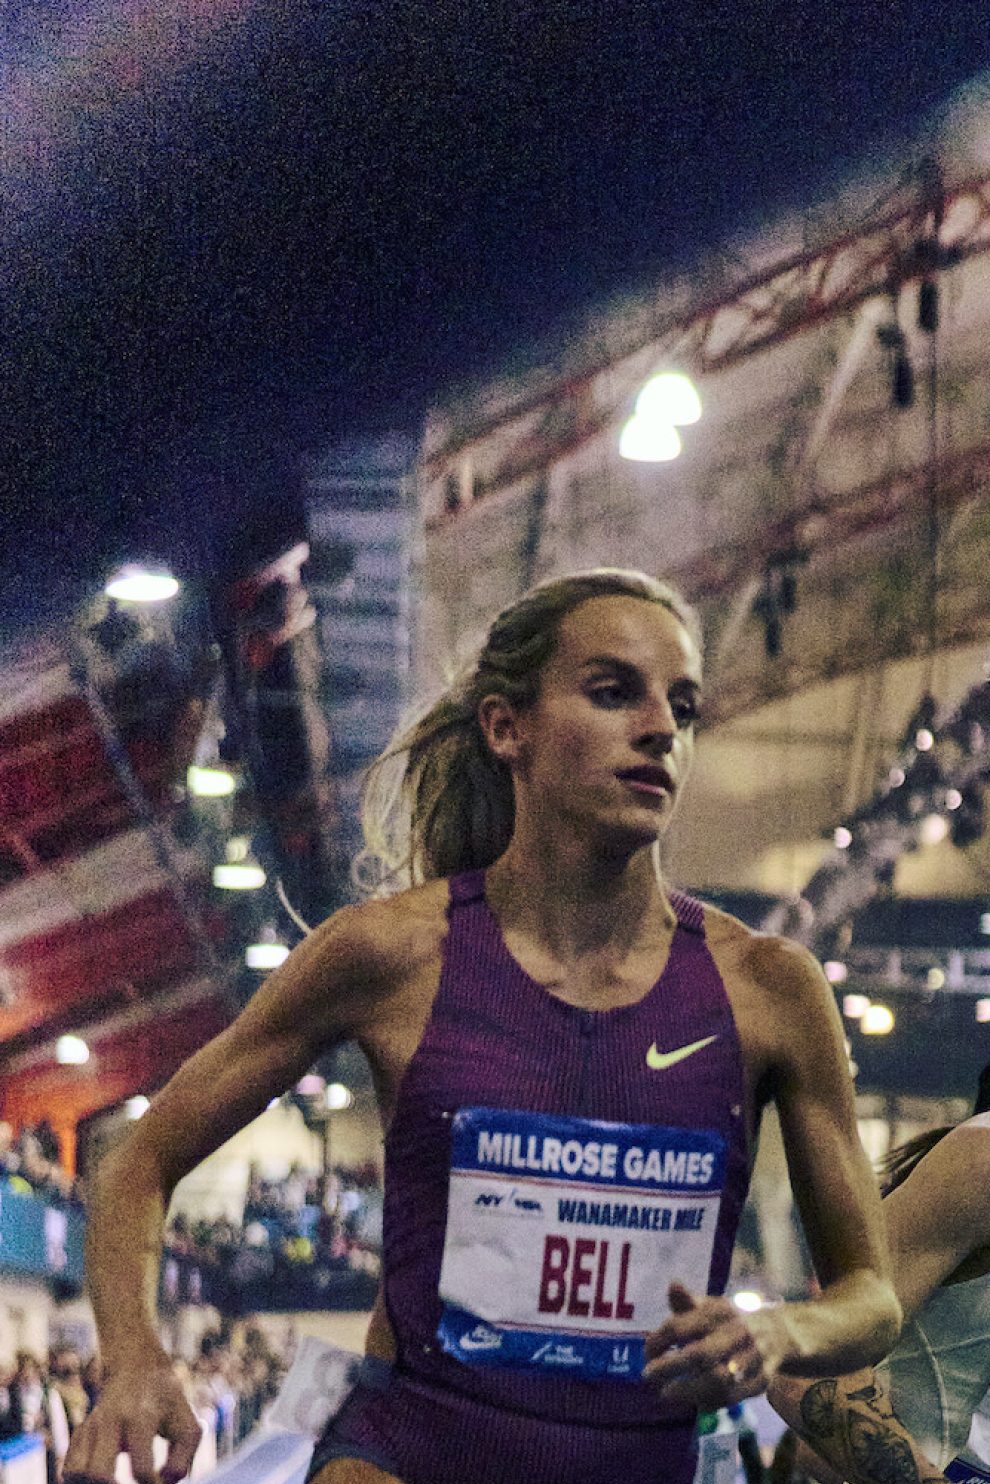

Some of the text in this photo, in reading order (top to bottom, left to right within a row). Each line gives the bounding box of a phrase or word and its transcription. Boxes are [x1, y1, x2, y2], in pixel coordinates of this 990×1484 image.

[477, 1131, 715, 1184] MILLROSE GAMES
[558, 1199, 671, 1231] WANAMAKER
[537, 1234, 634, 1320] BELL
